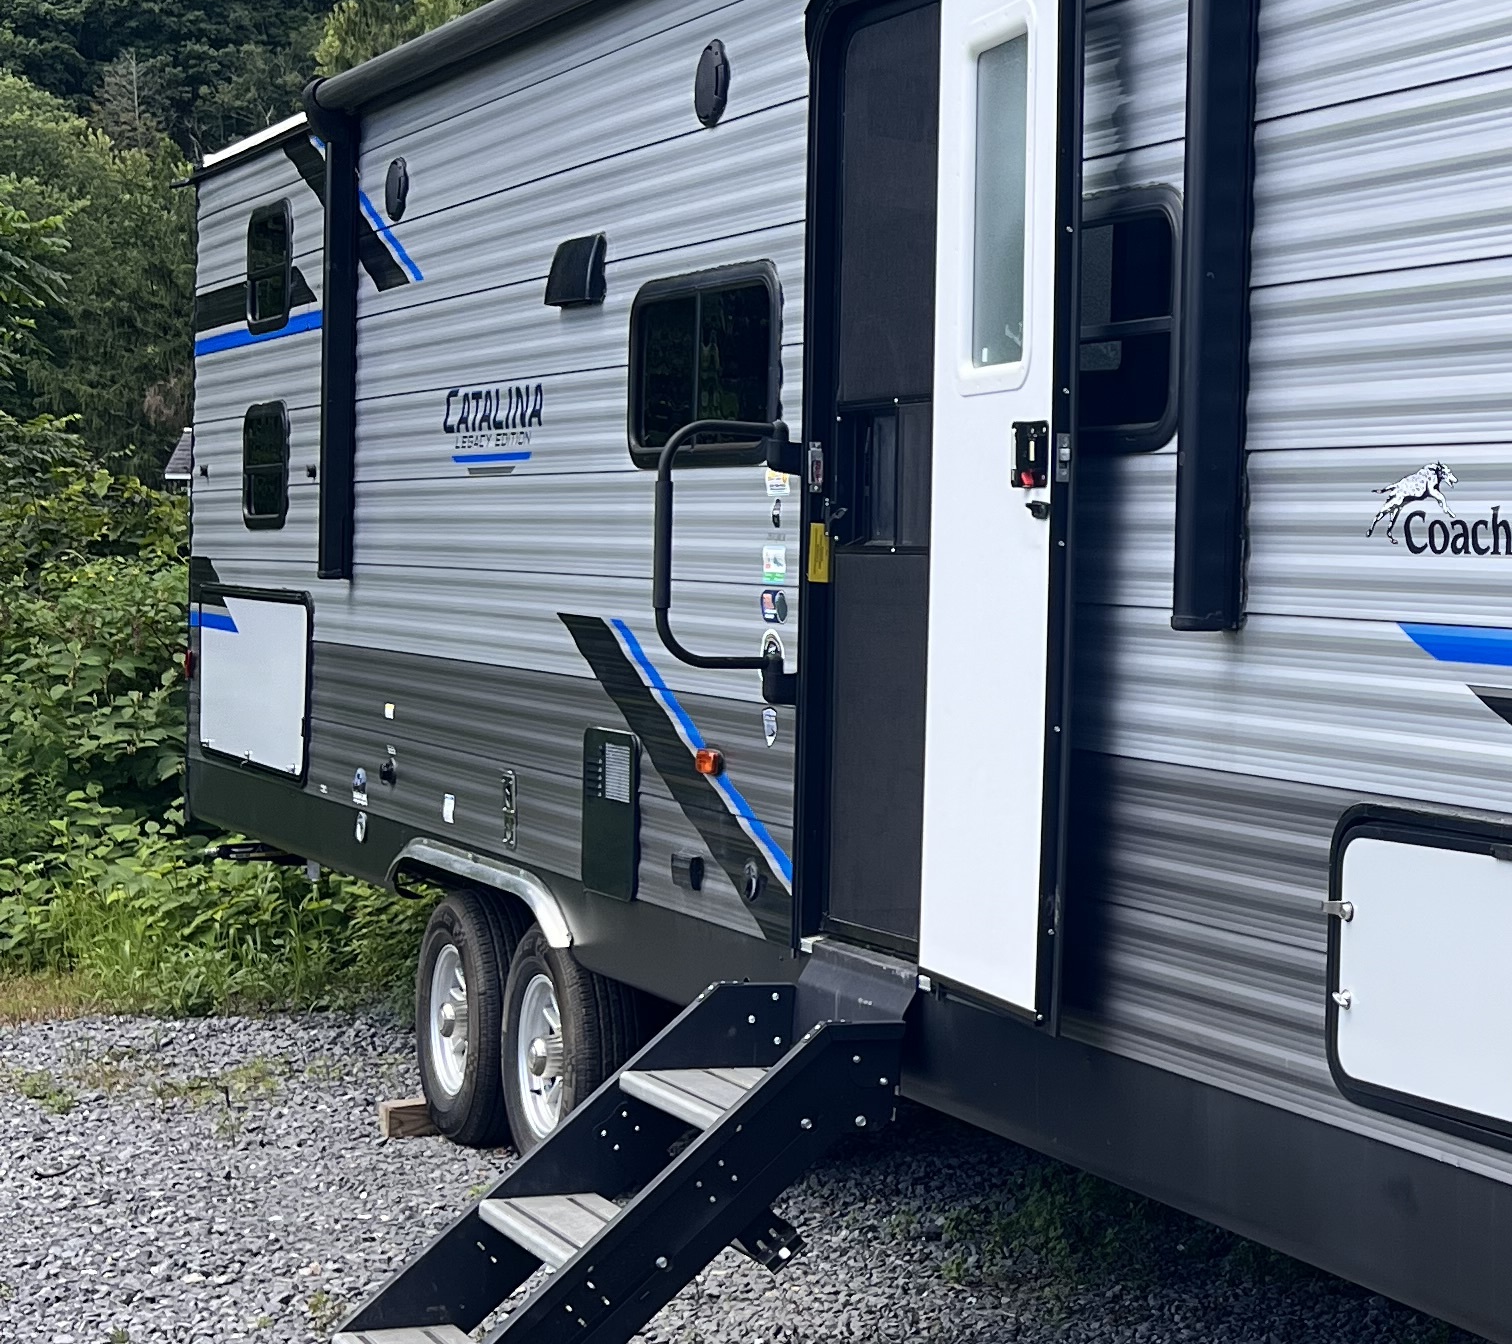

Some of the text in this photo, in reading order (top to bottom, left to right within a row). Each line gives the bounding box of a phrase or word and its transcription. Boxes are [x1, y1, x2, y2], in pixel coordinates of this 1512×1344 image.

[443, 383, 543, 433] CATALINA
[455, 430, 532, 449] LEGACY EDITION
